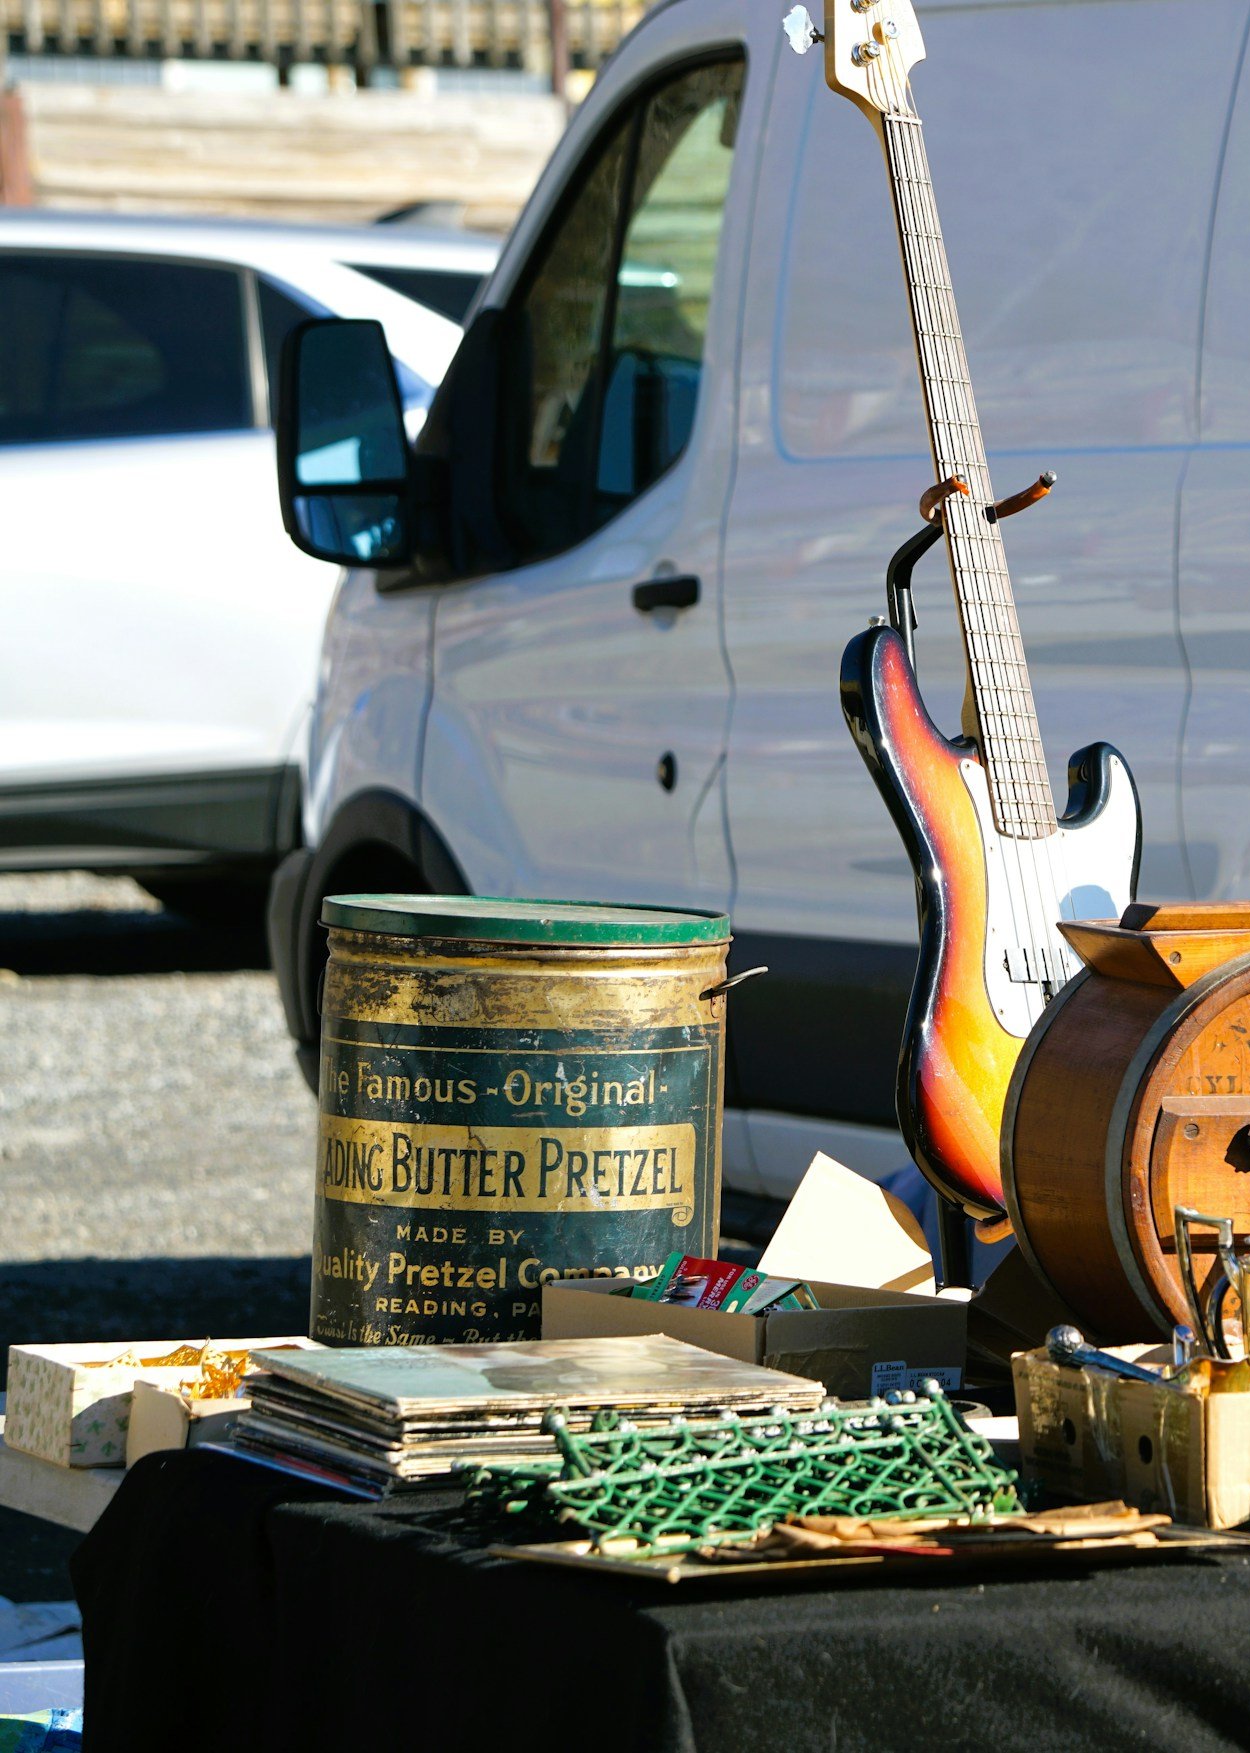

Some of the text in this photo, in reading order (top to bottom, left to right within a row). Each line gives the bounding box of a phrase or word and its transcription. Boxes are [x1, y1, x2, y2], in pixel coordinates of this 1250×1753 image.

[357, 1062, 477, 1104] Famous
[503, 1069, 655, 1117] Original
[396, 1225, 525, 1246] MADE BY
[388, 1252, 507, 1290] Pretzel
[703, 1278, 724, 1309] MERRY
[360, 1323, 382, 1344] the
[385, 1325, 436, 1346] Same
